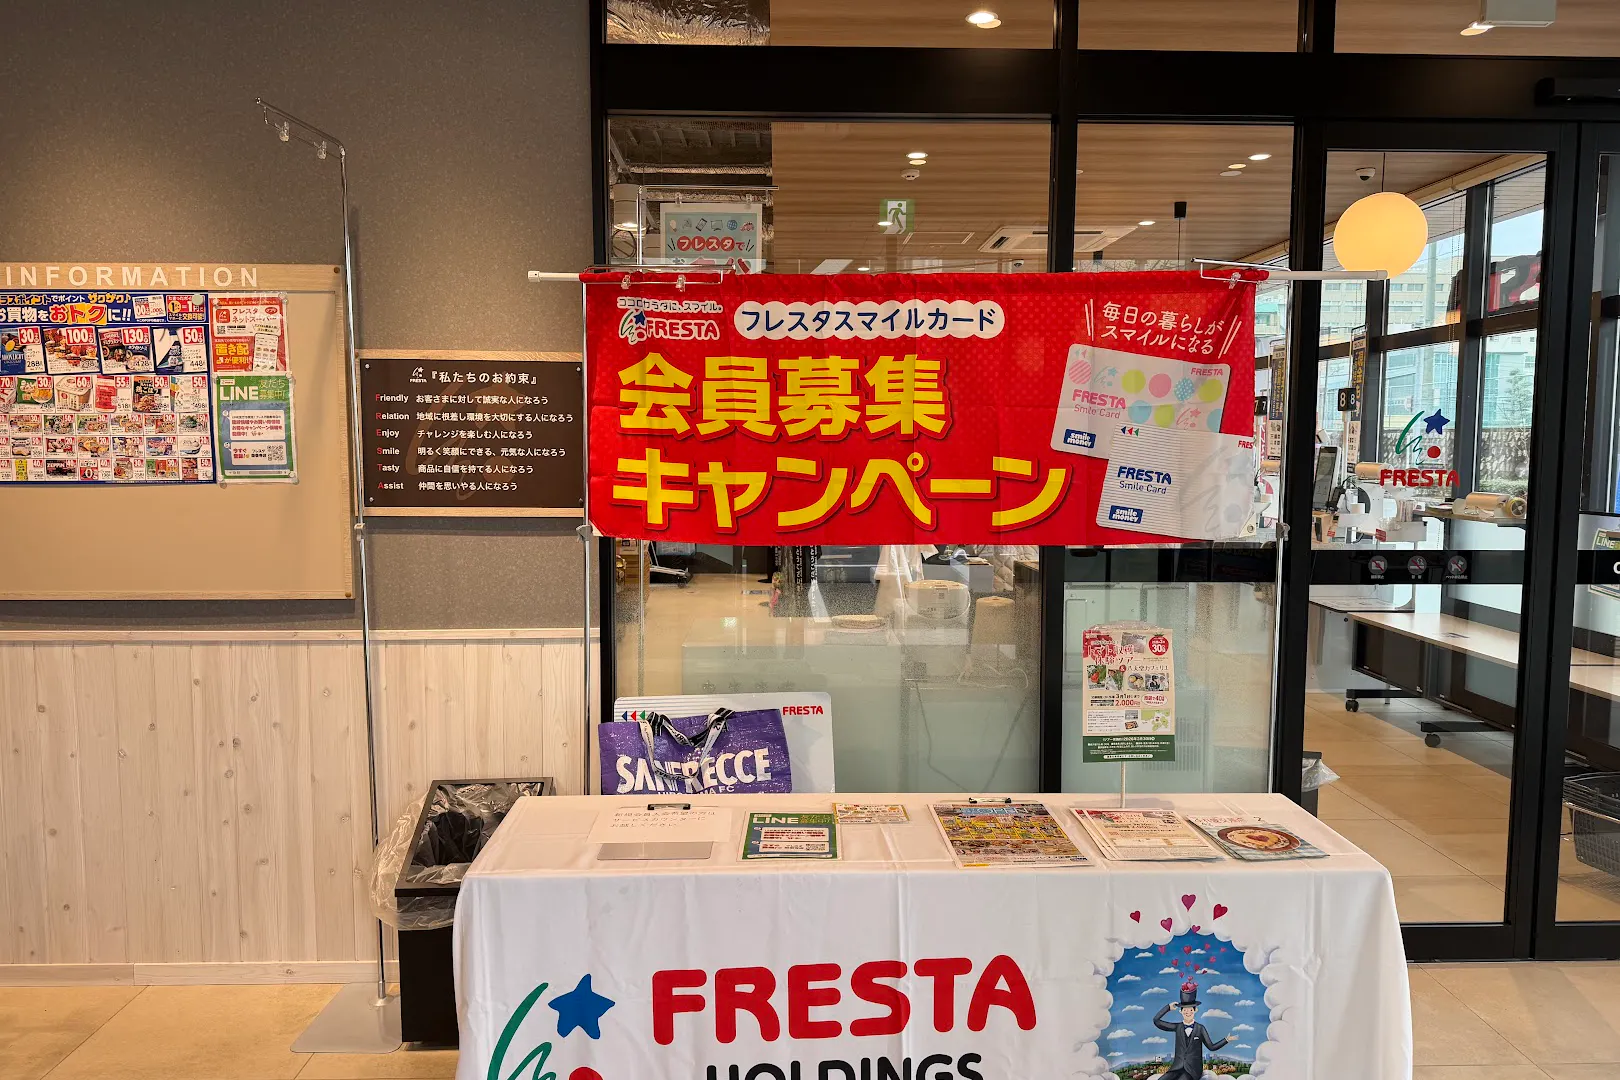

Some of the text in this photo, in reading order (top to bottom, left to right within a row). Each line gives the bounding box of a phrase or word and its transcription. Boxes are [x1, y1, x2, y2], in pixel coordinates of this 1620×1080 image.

[679, 237, 745, 252] フレスタで
[6, 266, 258, 287] INFORMATION
[741, 306, 997, 334] フレスタスマイルカード
[1101, 301, 1223, 336] 毎日の暮らしが
[68, 328, 88, 343] 100
[124, 328, 144, 343] 130
[184, 328, 198, 343] 50
[646, 320, 718, 338] FRESTA
[1100, 325, 1215, 356] スマイルになる
[216, 344, 249, 356] 置き配
[430, 370, 538, 385] 『私たちのお約束』
[1190, 367, 1224, 377] FRESTA
[259, 378, 286, 388] 友だち
[220, 386, 258, 400] LINE
[375, 394, 549, 405] Friendly お客さまに対して誠実な人になろう
[617, 352, 947, 436] 会員募集
[1072, 389, 1126, 410] FRESTA
[1340, 392, 1356, 408] 8 8
[376, 412, 574, 422] Relation 地域に根差し環境を大切にする人になろう
[1074, 403, 1121, 419] Smile Card
[376, 428, 533, 440] Enjoy チャレンジを楽しむ人になろう
[1069, 432, 1091, 442] smile
[1066, 437, 1092, 448] money
[1237, 439, 1254, 449] FRES
[376, 446, 566, 458] Smile 明るく笑顔にできる、元気な人になろう
[377, 464, 534, 474] Tasty 商品に自信を持てる人になろう
[1117, 466, 1172, 485] FRESTA
[1380, 469, 1460, 487] FRESTA
[378, 482, 518, 491] Assist 仲間を思いやる人になろう
[612, 447, 1067, 529] キャンペーン
[1119, 480, 1167, 495] Smile Card
[1112, 513, 1139, 523] money
[1115, 508, 1138, 517] smile
[1596, 536, 1616, 549] LINE
[782, 705, 824, 716] FRESTA
[616, 747, 772, 793] SANFRECCE
[752, 816, 799, 824] LINE
[652, 955, 1037, 1046] FRESTA
